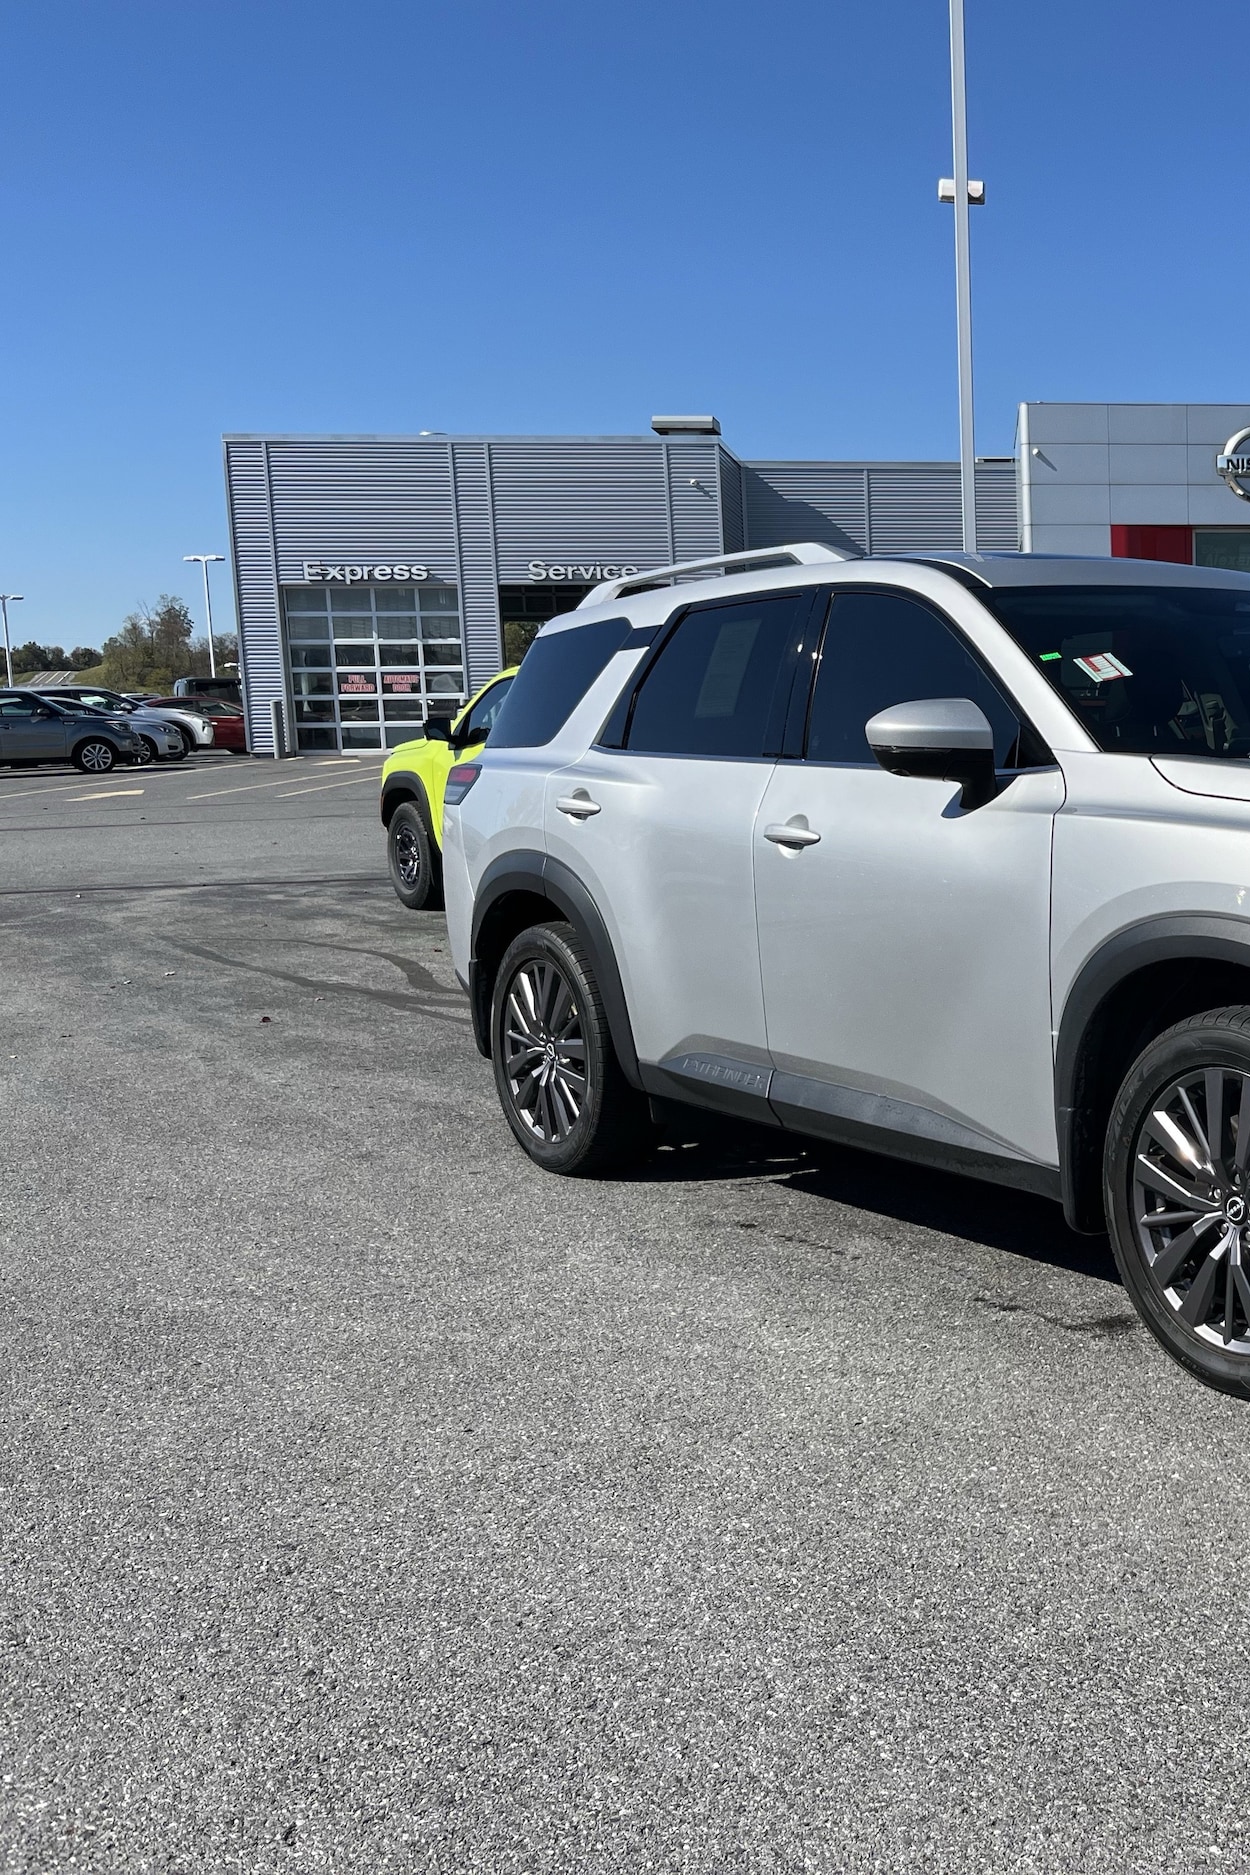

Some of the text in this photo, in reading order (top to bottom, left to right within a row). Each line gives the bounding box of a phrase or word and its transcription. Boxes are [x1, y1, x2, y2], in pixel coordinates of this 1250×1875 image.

[302, 560, 429, 585] Express
[527, 560, 639, 581] Service
[340, 683, 375, 692] FORWARD
[682, 1058, 764, 1089] PATHFINDER
